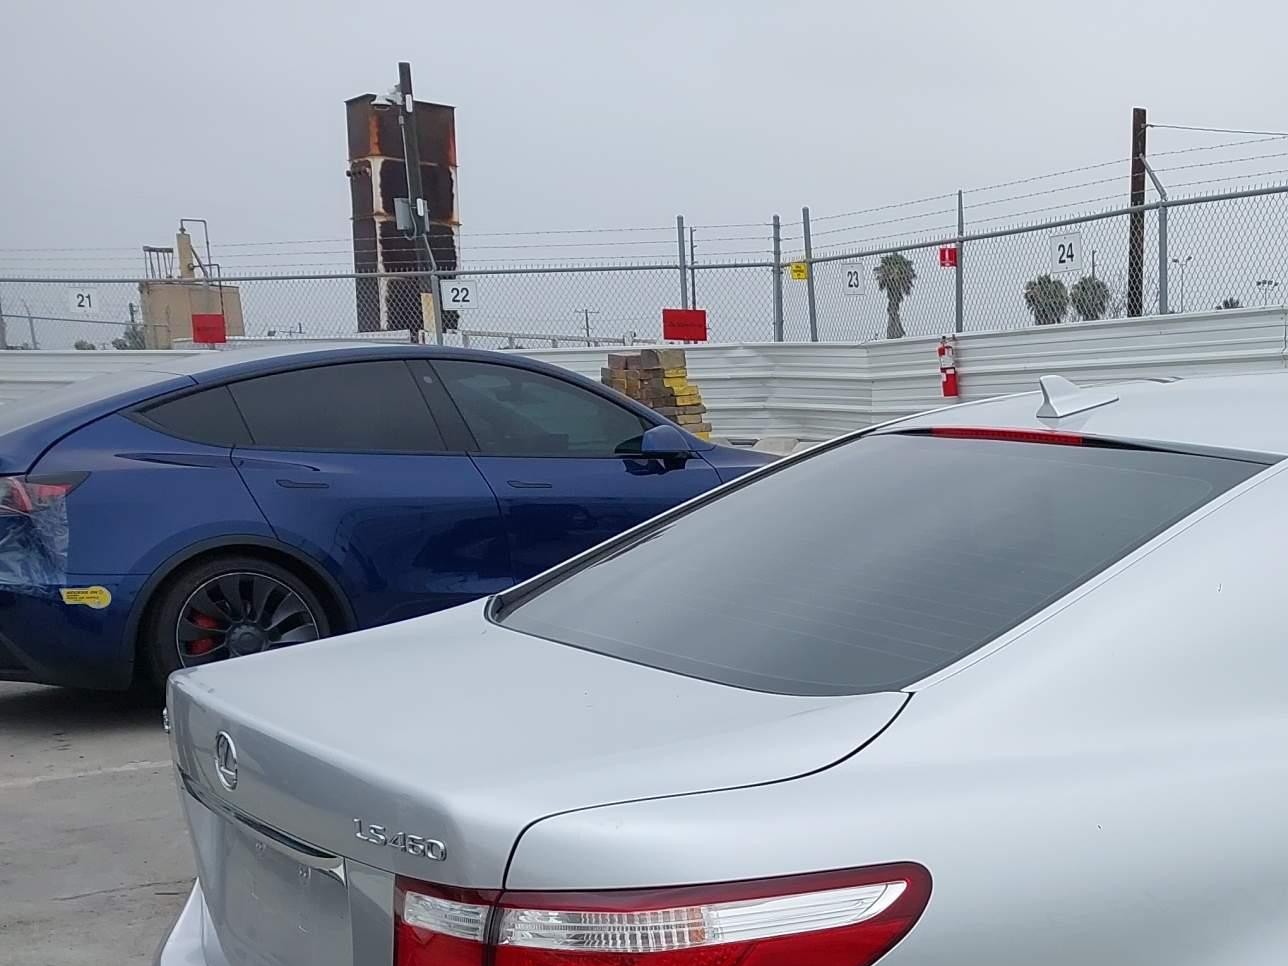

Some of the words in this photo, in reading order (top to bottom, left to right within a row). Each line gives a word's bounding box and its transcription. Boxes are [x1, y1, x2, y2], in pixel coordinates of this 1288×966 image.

[1057, 242, 1075, 264] 24
[847, 270, 860, 288] 23
[76, 293, 92, 309] 21
[450, 287, 471, 303] 22
